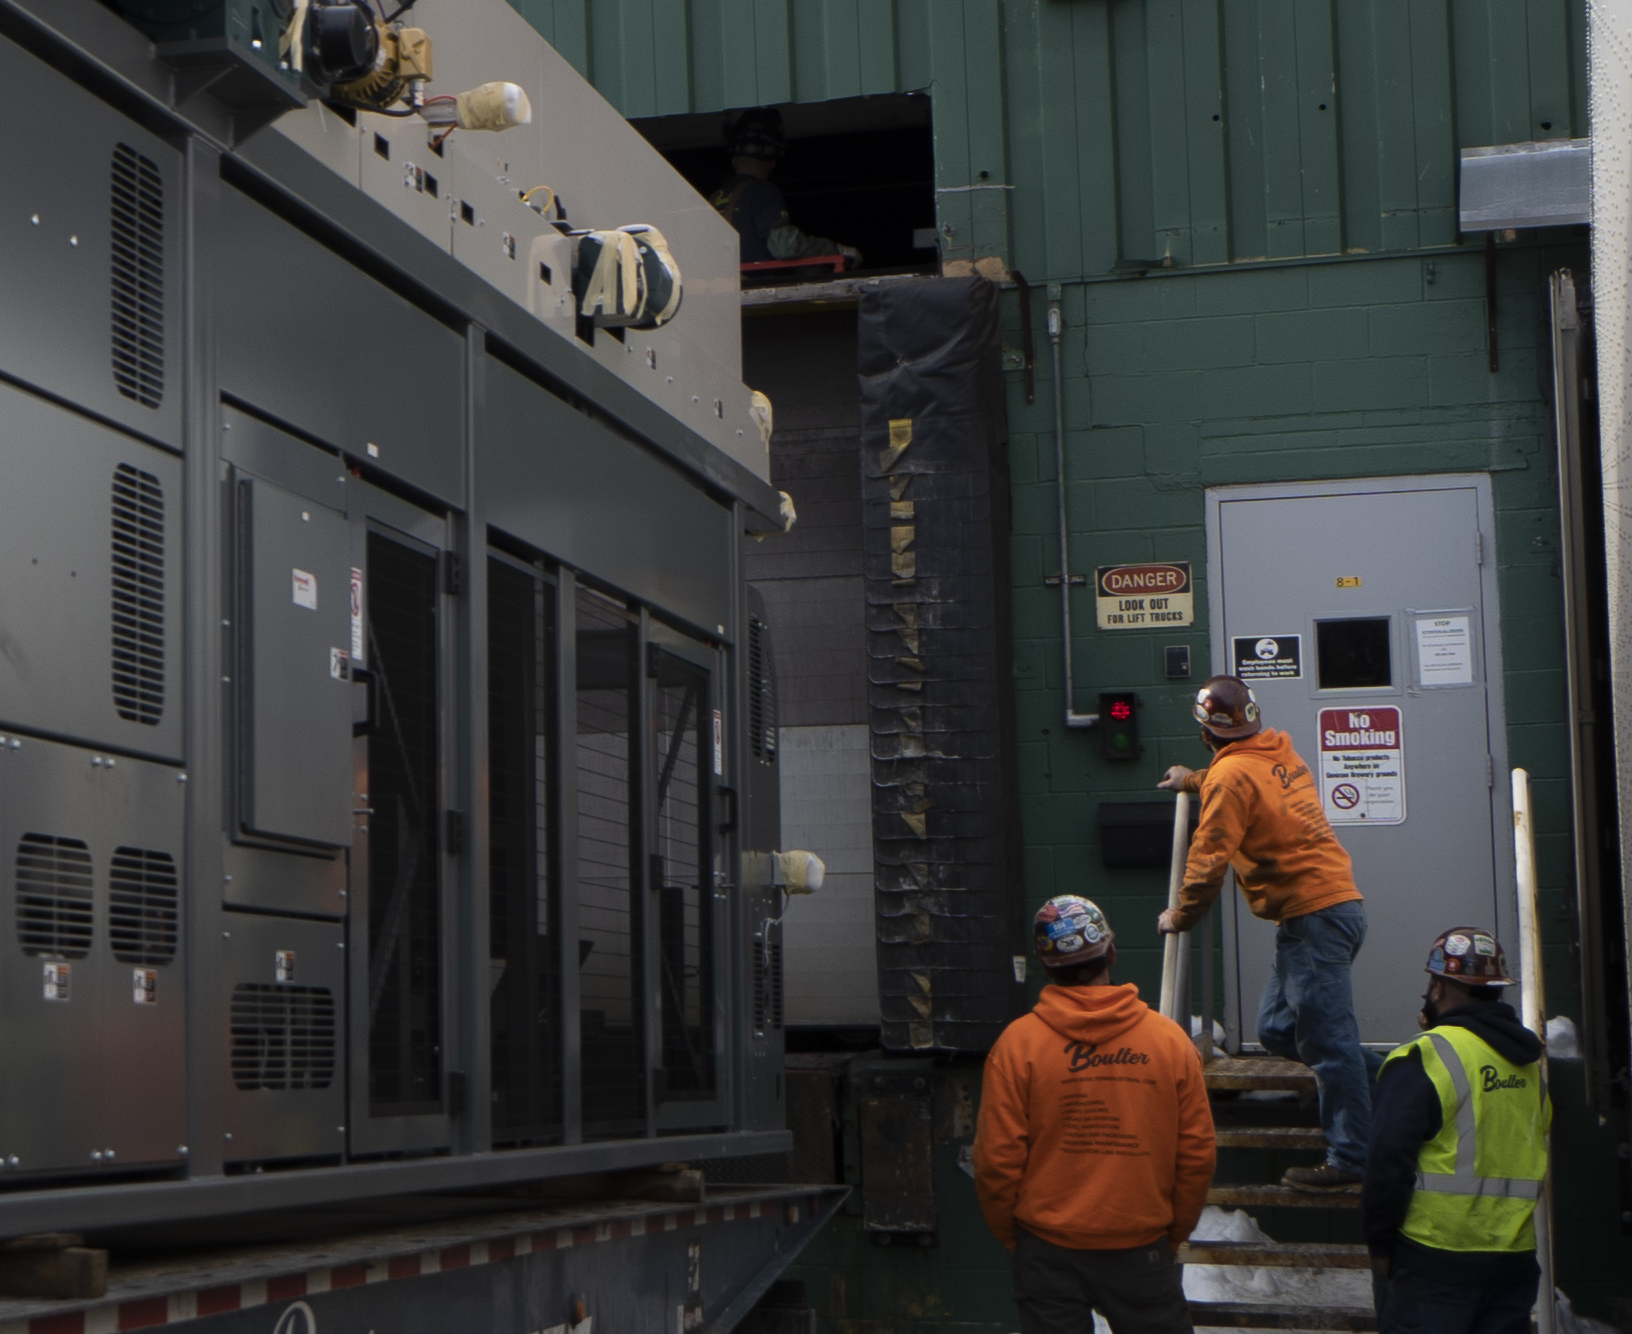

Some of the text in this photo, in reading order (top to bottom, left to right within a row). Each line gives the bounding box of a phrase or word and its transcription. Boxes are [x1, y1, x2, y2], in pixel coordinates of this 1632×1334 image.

[1111, 571, 1177, 589] DANGER
[1119, 597, 1169, 612] LOOK OUT
[1107, 611, 1183, 624] FOR LIFT TRUCKS
[1348, 713, 1371, 729] No
[1325, 728, 1396, 747] Smoking
[1365, 753, 1391, 762] products
[1376, 770, 1398, 778] grounds
[1064, 1040, 1150, 1073] Boulter
[1480, 1064, 1527, 1093] Boulter
